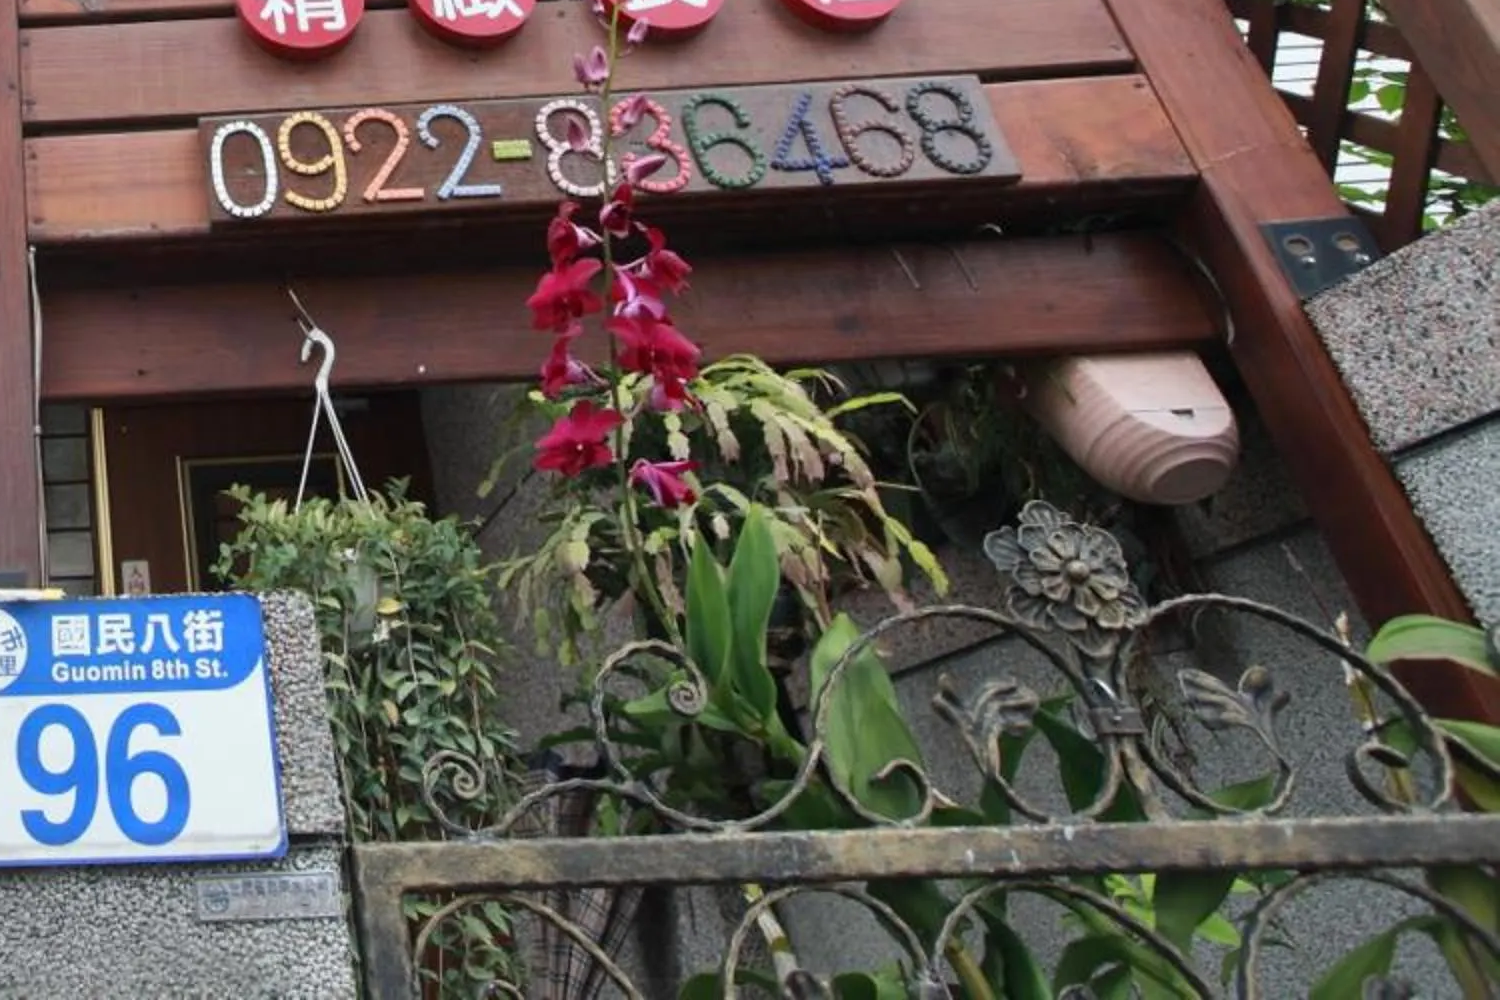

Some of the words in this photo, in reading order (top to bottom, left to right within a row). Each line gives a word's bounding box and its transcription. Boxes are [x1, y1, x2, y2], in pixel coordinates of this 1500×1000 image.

[210, 80, 993, 221] 0922-836468
[50, 609, 225, 657] 國民八街
[51, 660, 146, 683] Guomin
[151, 658, 190, 680] 8th
[195, 657, 229, 679] St.
[16, 702, 191, 846] 96
